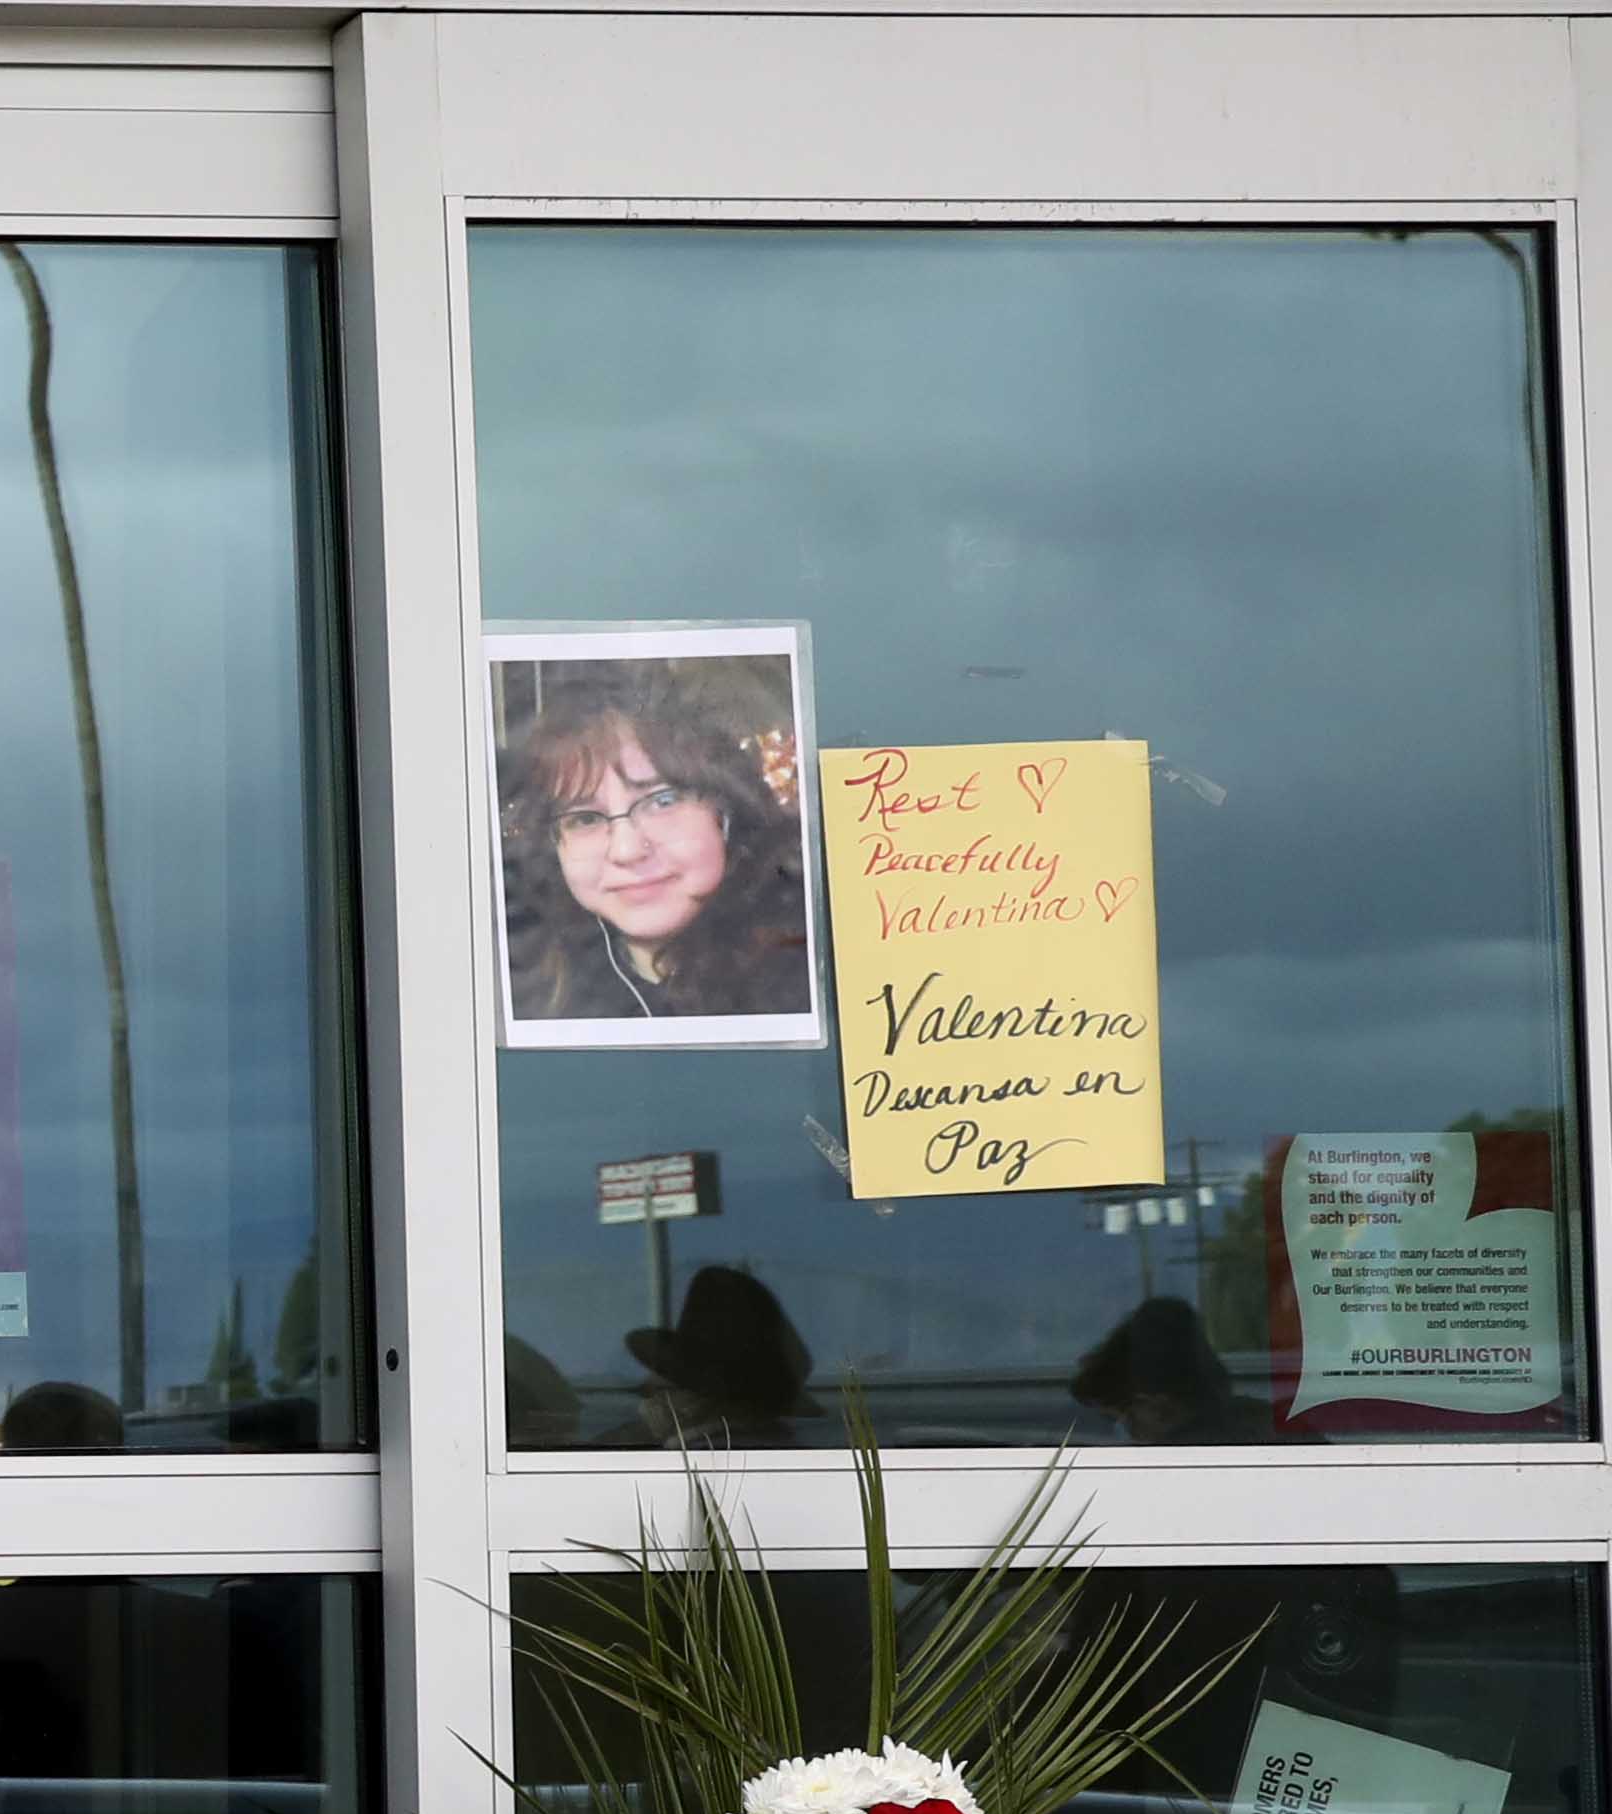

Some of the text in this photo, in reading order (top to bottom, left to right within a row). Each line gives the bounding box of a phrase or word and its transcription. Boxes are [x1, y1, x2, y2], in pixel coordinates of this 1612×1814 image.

[845, 749, 981, 831] Rest
[859, 834, 1060, 898] Peacefully
[875, 889, 1085, 941] Valentina
[866, 972, 1148, 1056] Valentina
[853, 1070, 1146, 1118] Descansa en
[925, 1120, 1088, 1186] Paz
[1308, 1150, 1432, 1166] At Burlington, we
[1308, 1170, 1434, 1187] stand for equality
[1309, 1190, 1435, 1206] and the dignity of
[1310, 1211, 1402, 1227] each person.
[1310, 1248, 1527, 1262] We embrace the many facets of diversity
[1332, 1265, 1527, 1280] that strengthen our communities and
[1312, 1284, 1331, 1296] Our
[1395, 1283, 1412, 1295] We
[1415, 1283, 1452, 1294] believe
[1455, 1283, 1477, 1294] that
[1480, 1285, 1528, 1297] everyone
[1340, 1300, 1529, 1313] deserves to be treated with respect
[1427, 1318, 1530, 1330] and understanding.
[1350, 1347, 1532, 1364] #OURBURLINGTON
[1289, 1750, 1315, 1781] TO
